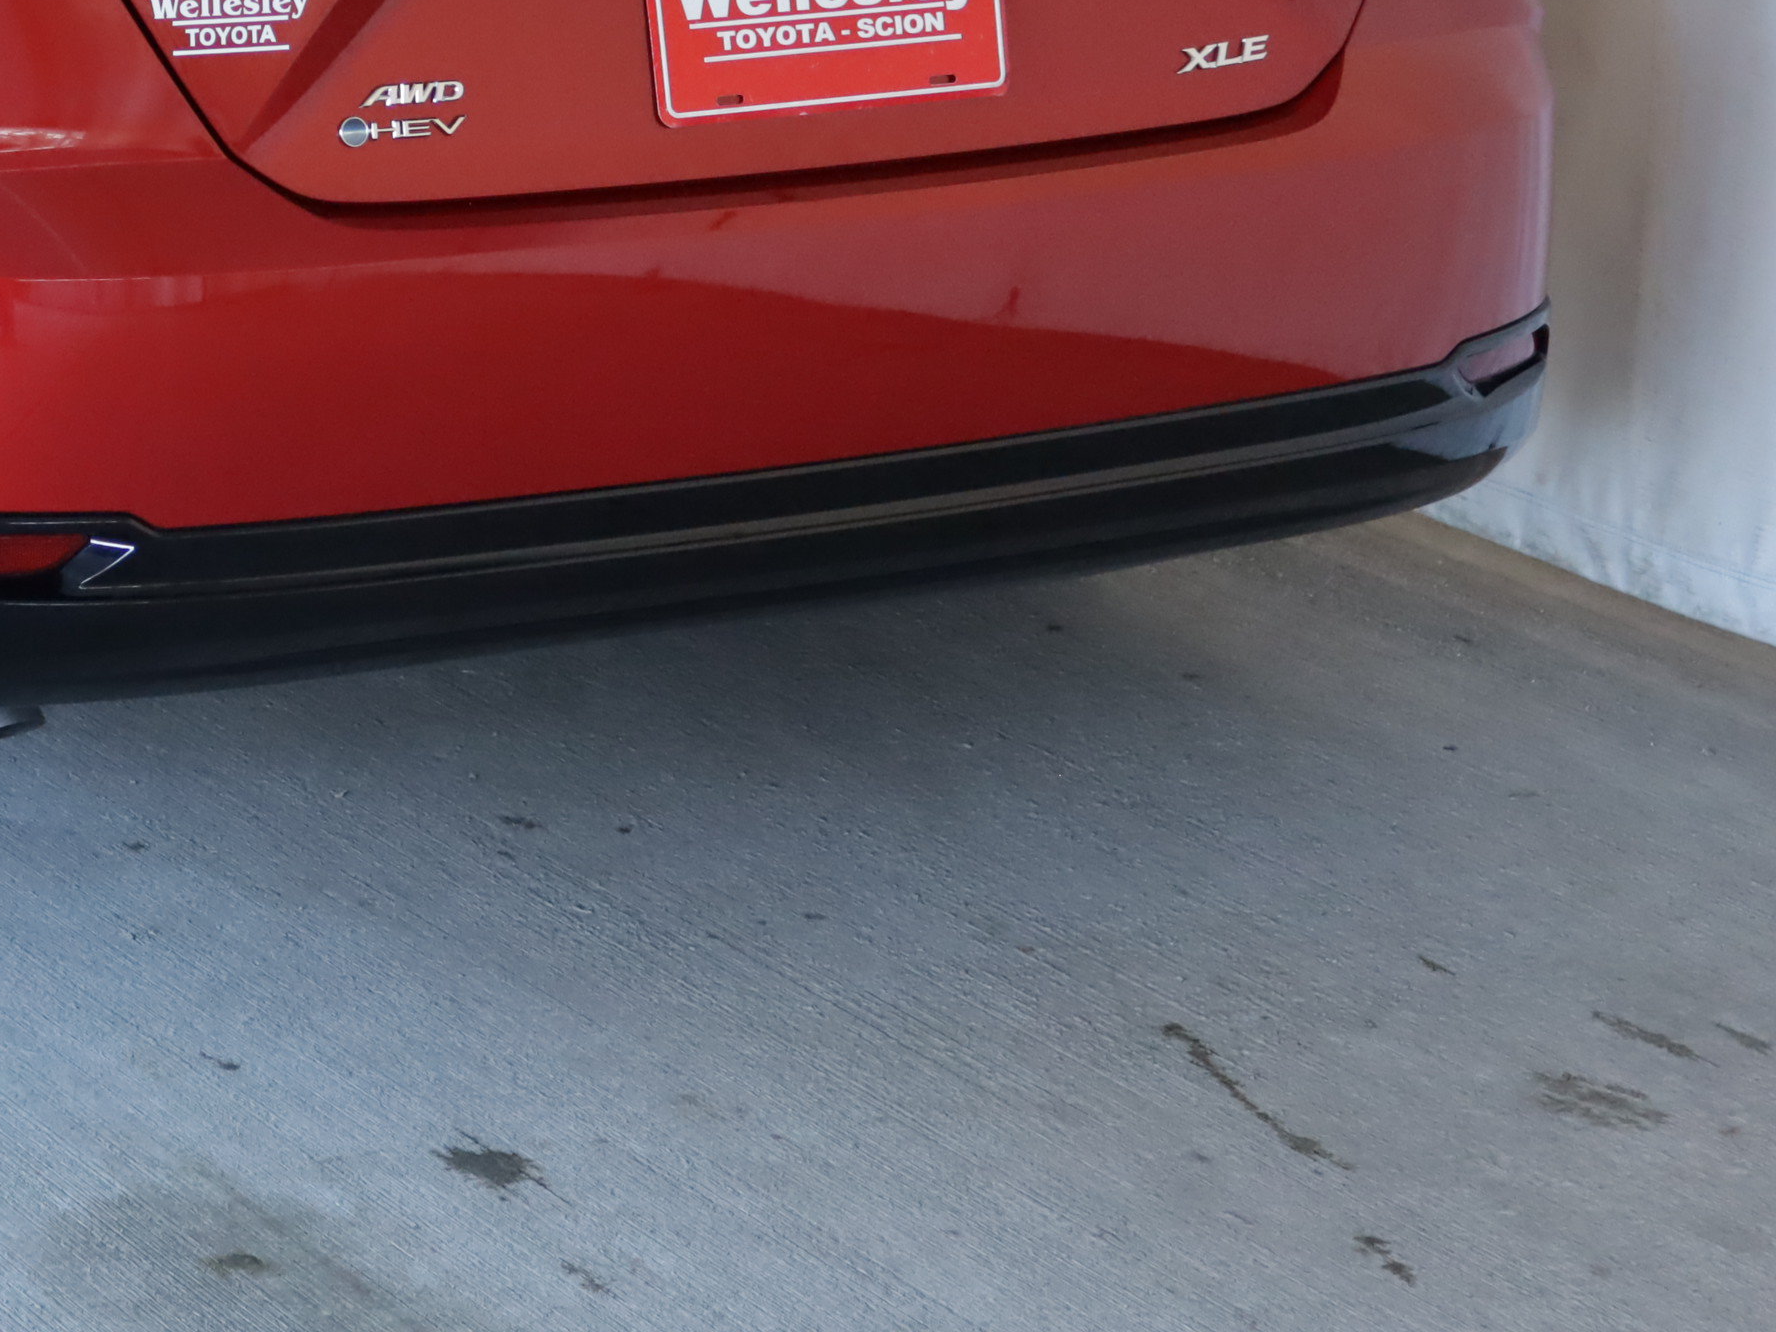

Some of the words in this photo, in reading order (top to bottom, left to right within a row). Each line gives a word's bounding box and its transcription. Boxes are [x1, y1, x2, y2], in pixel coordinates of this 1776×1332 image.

[184, 24, 277, 48] TOYOTA
[717, 21, 836, 51] TOYOTA
[856, 11, 946, 39] SCION
[1176, 34, 1270, 75] XLE
[358, 80, 466, 109] AWD
[369, 115, 468, 141] HEV
